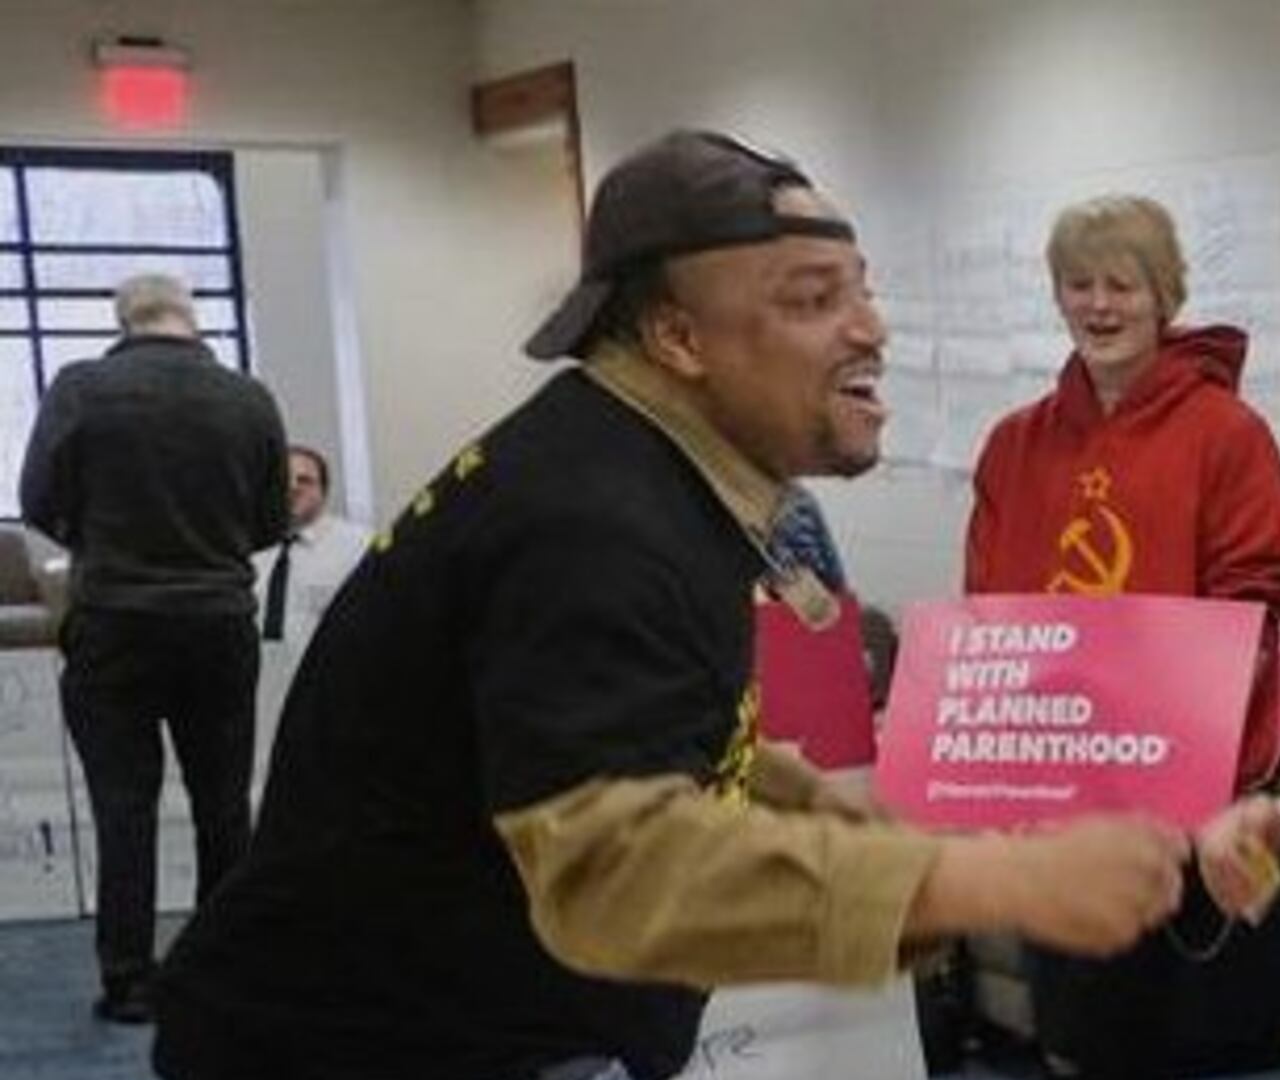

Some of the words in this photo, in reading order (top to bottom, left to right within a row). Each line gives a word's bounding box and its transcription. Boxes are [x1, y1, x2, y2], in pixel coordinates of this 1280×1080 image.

[950, 625, 963, 655] I
[966, 623, 1078, 654] STAND
[945, 660, 1030, 691] WITH
[936, 695, 1093, 727] PLANNED
[930, 731, 1170, 766] PARENTHOOD
